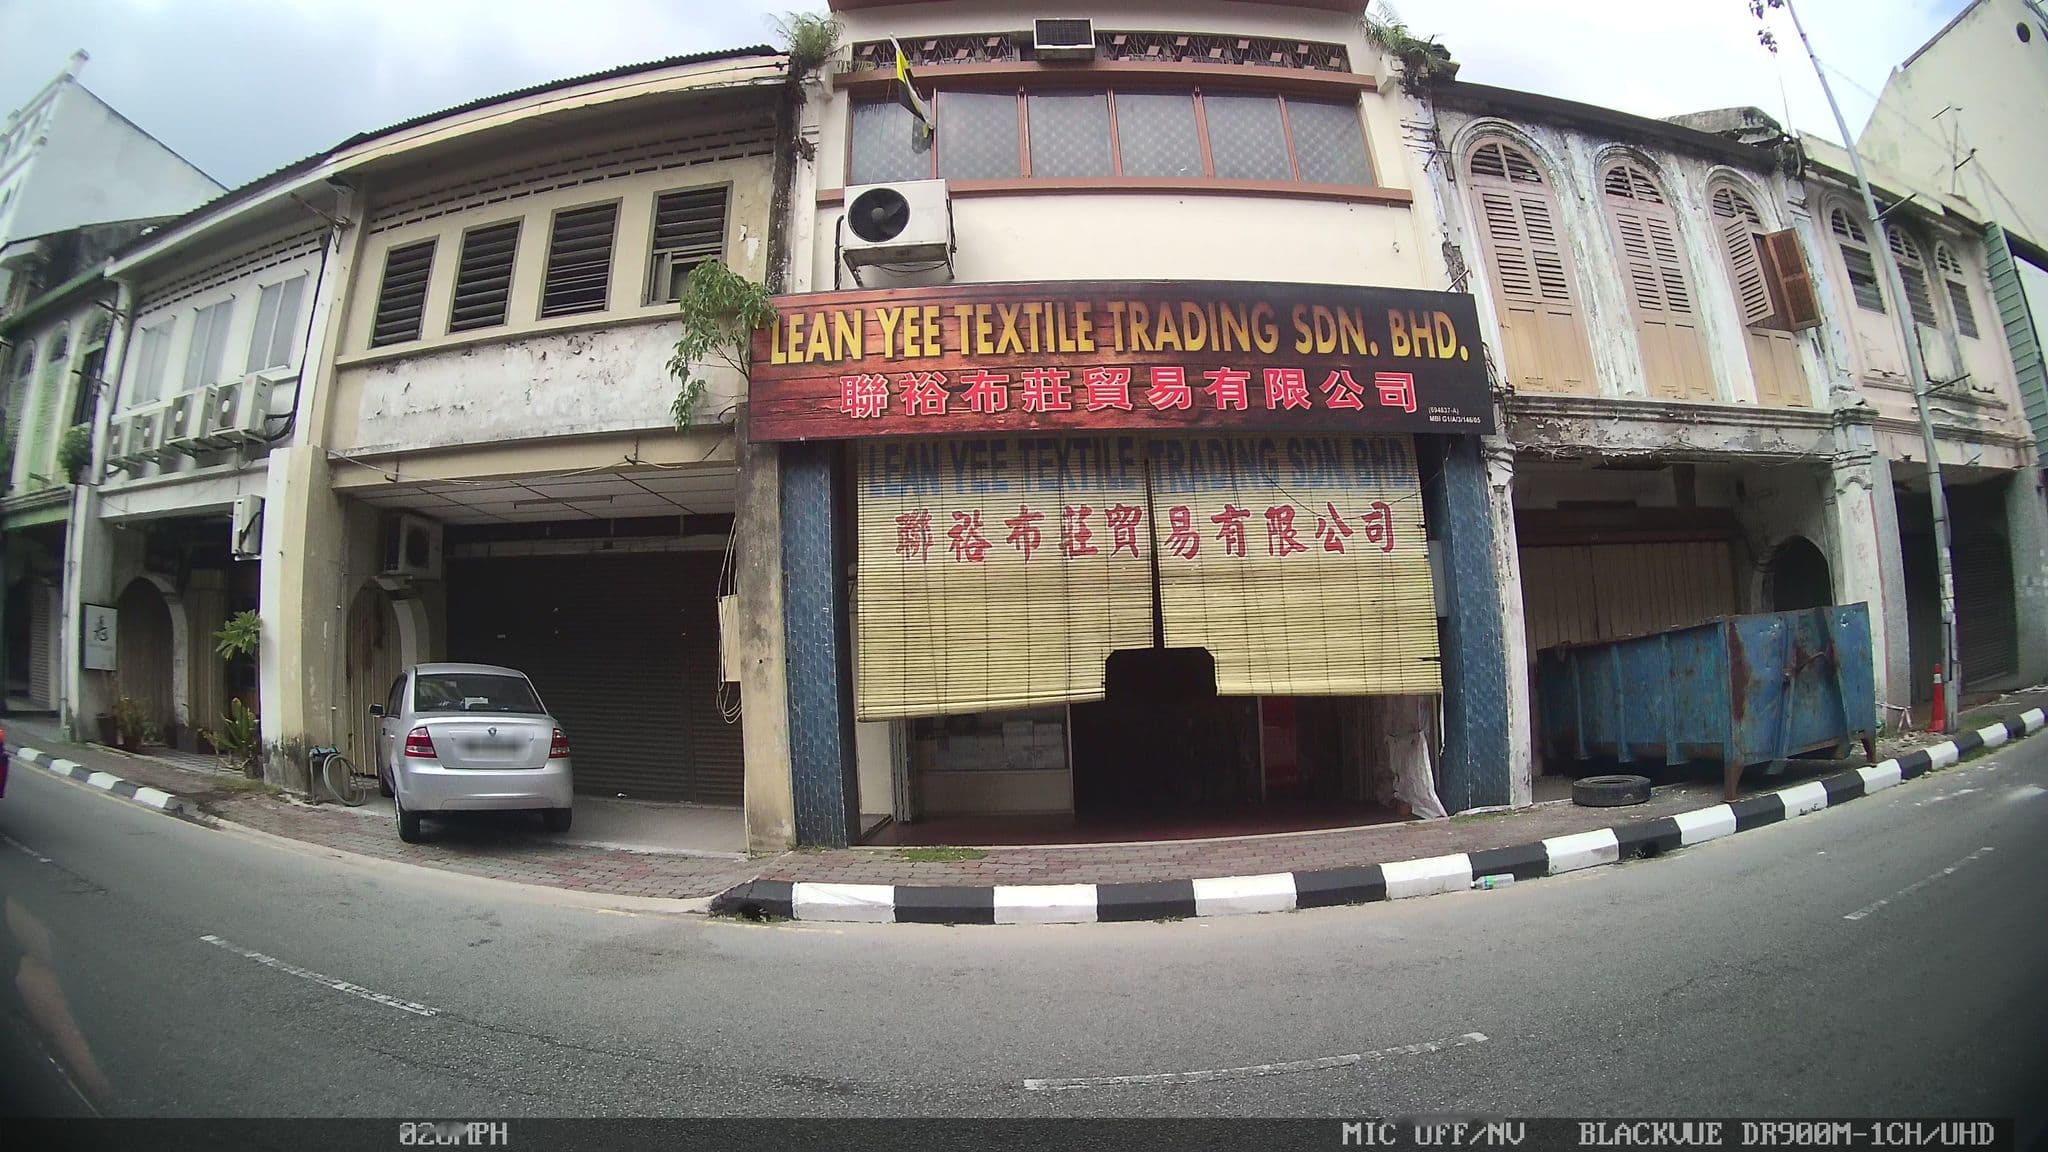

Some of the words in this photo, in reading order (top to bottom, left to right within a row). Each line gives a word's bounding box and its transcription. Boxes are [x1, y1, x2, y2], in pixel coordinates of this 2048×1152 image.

[770, 308, 862, 365] LEAN
[876, 305, 941, 359] YEE
[955, 301, 1096, 355] TEXTILE
[1106, 300, 1280, 355] TRADING
[1291, 302, 1379, 358] SDN.
[1387, 308, 1470, 362] BHD.
[839, 366, 1418, 420] 聯裕布莊貿易有限公司
[868, 440, 942, 497] LEAN
[951, 438, 1009, 495] YEE
[1022, 437, 1137, 493] TEXTILE
[1149, 437, 1280, 493] TRADING
